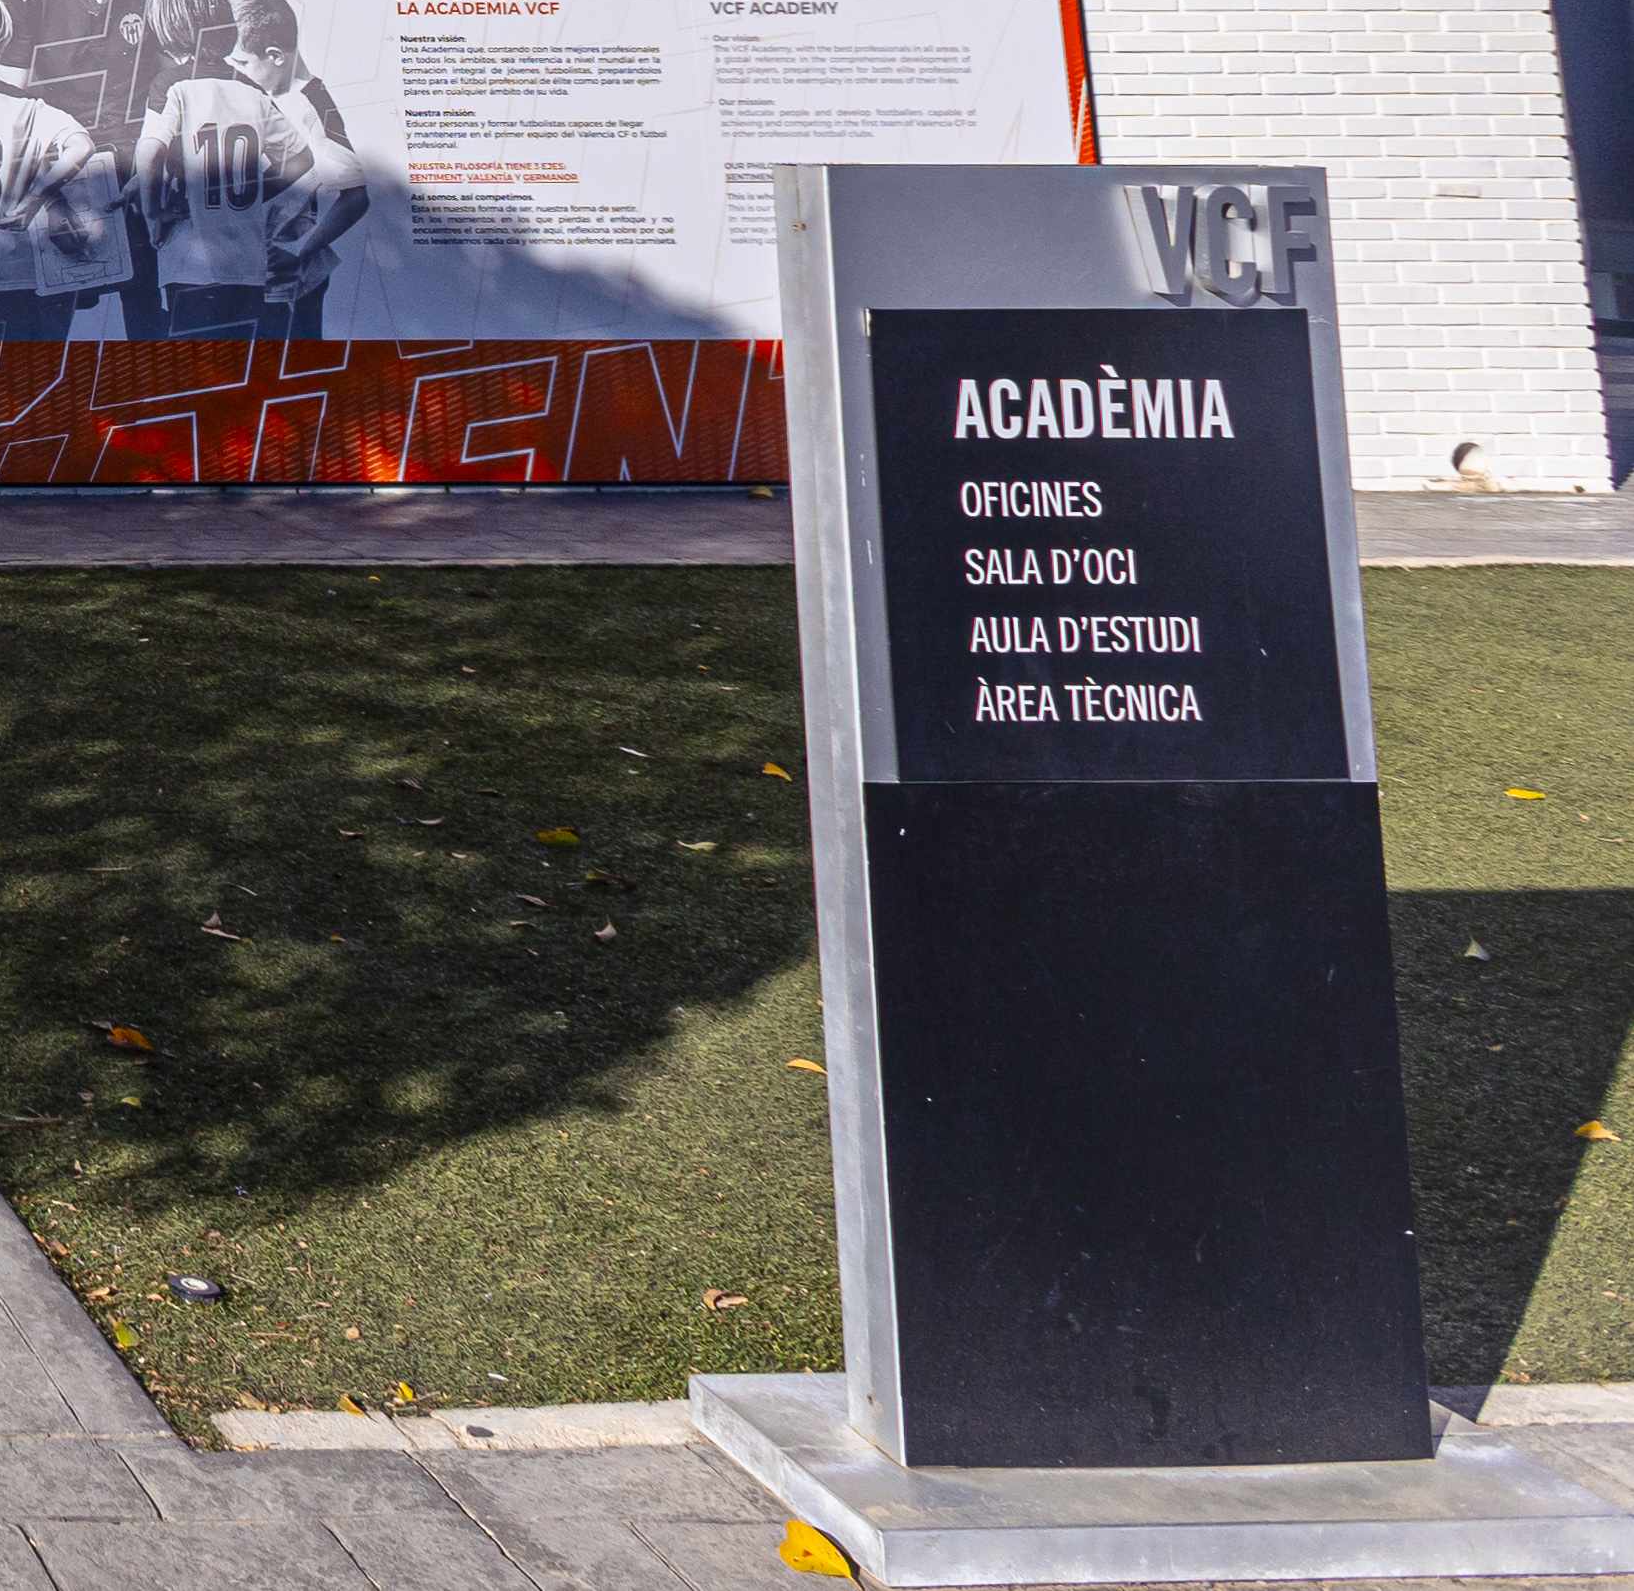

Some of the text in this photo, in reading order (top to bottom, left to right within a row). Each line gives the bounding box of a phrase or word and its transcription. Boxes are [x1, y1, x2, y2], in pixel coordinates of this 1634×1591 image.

[397, 1, 560, 16] LA ACADEMIA VCF
[709, 1, 838, 15] VCF ACADEMY
[400, 34, 466, 43] Nuestra visión:
[405, 108, 475, 117] Nuestra misión:
[407, 140, 457, 151] profesional.
[194, 123, 262, 211] 10
[467, 173, 514, 183] VALENTÍA
[514, 173, 521, 181] Y
[411, 193, 534, 202] Así somos, así competimos.
[1134, 185, 1314, 307] VCF
[954, 364, 1235, 439] ACADÈMIA
[961, 481, 1103, 517] OFICINES
[965, 548, 1043, 585] SALA
[970, 616, 1052, 652] AULA
[975, 677, 1203, 721] ÀREA TÈCNICA
